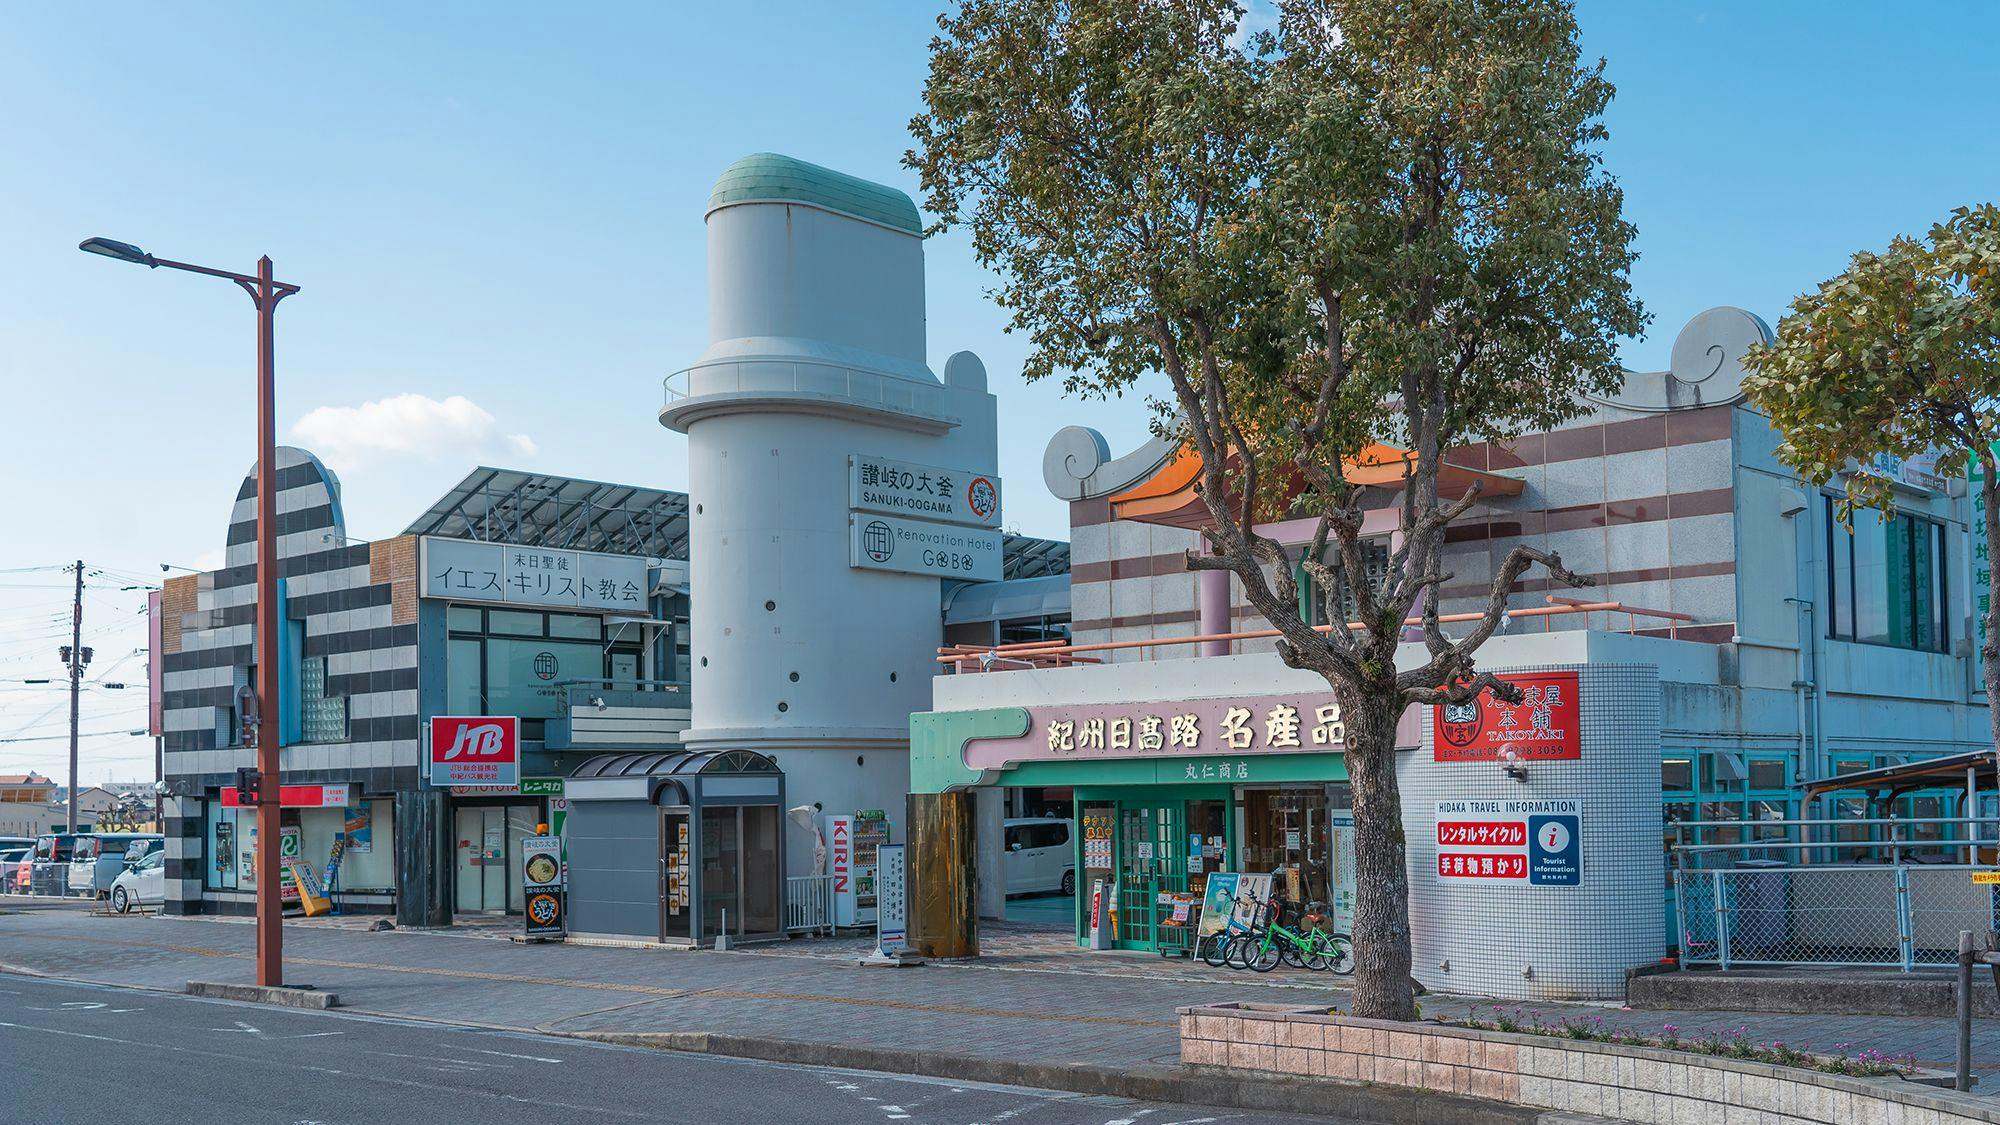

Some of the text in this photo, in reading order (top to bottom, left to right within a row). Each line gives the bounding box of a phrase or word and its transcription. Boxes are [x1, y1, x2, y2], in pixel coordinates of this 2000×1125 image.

[863, 491, 953, 514] SANUKI-OOGAMA
[897, 528, 996, 551] Renovation Hotel
[514, 552, 569, 571] 末日聖徒
[435, 566, 640, 602] イエス・キリスト教会
[1487, 685, 1564, 708] ま屋
[1219, 703, 1347, 750] 名産品
[1486, 729, 1564, 742] TAKOYAKI
[444, 723, 505, 760] JTB
[1184, 760, 1249, 780] 丸仁商店
[1438, 801, 1576, 813] HIDAKA TRAVEL INFORMATION
[1440, 826, 1522, 843] レンタルサイクル
[833, 820, 848, 894] KIRIN
[1441, 857, 1523, 875] 手荷物預かり
[1542, 857, 1566, 865] Tourist
[1534, 865, 1576, 873] Information
